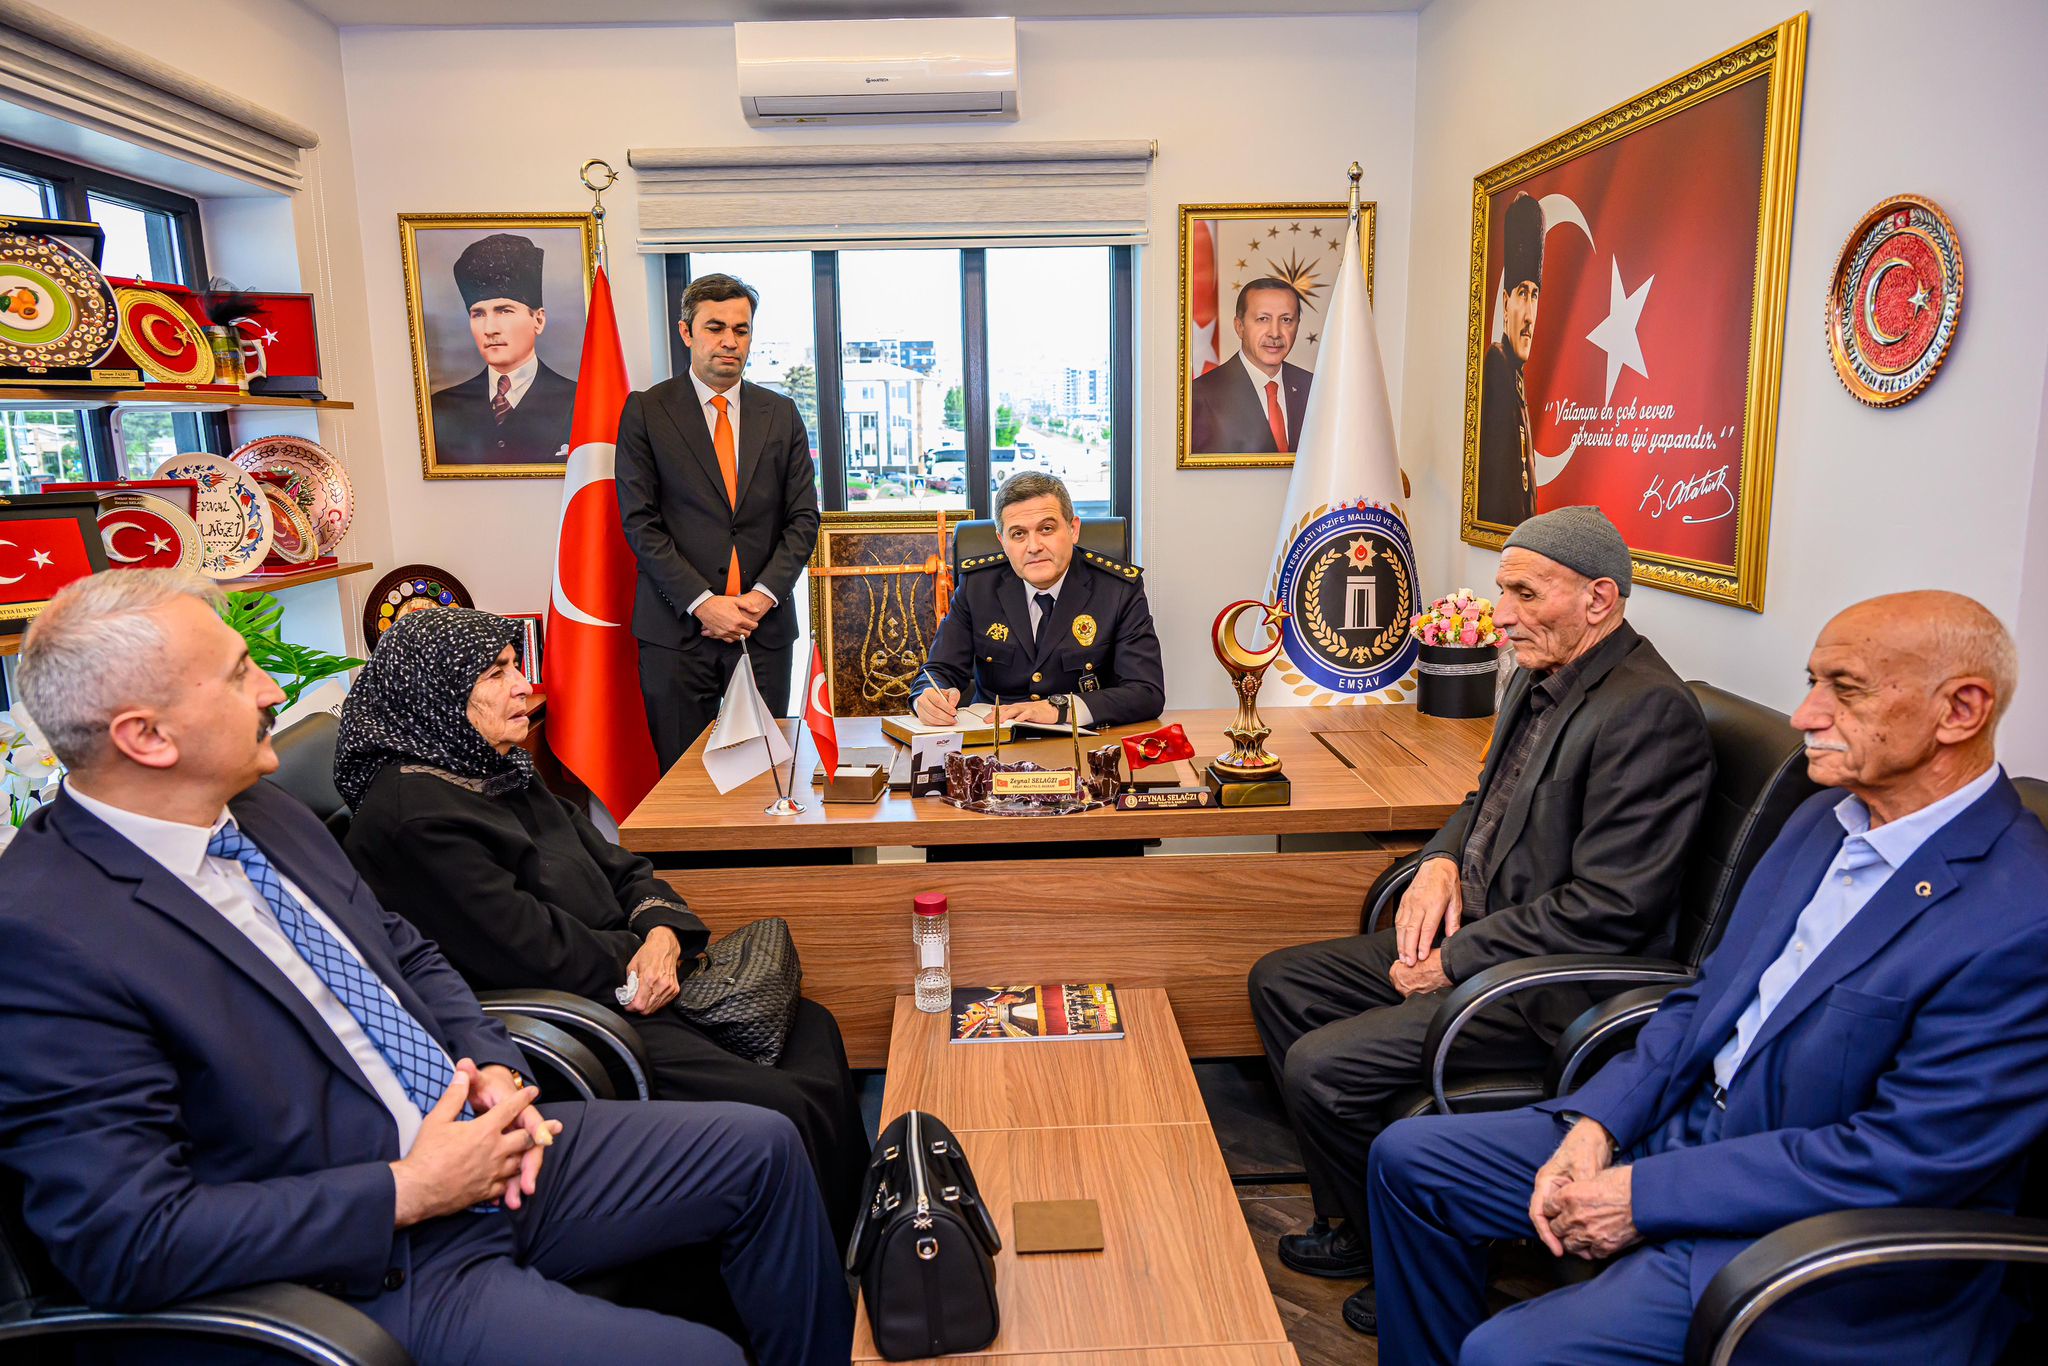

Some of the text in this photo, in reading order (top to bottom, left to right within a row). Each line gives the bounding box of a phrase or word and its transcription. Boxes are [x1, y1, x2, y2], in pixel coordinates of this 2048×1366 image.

[1600, 406, 1615, 421] en
[1616, 396, 1637, 428] çok
[1639, 404, 1675, 420] seven
[1615, 431, 1630, 447] en
[1631, 427, 1650, 454] iyi
[196, 501, 230, 512] EYNAL
[197, 519, 241, 538] LAĞZI
[1287, 531, 1316, 570] TEŞKİLATI
[1315, 514, 1346, 533] VAZİFE
[1347, 512, 1382, 522] MALULÜ
[1382, 516, 1393, 526] VE
[1392, 521, 1408, 542] ŞEHİT
[1338, 676, 1380, 691] EMŞAV
[1010, 777, 1031, 786] Zeynal
[1167, 792, 1197, 801] SELAĞZI
